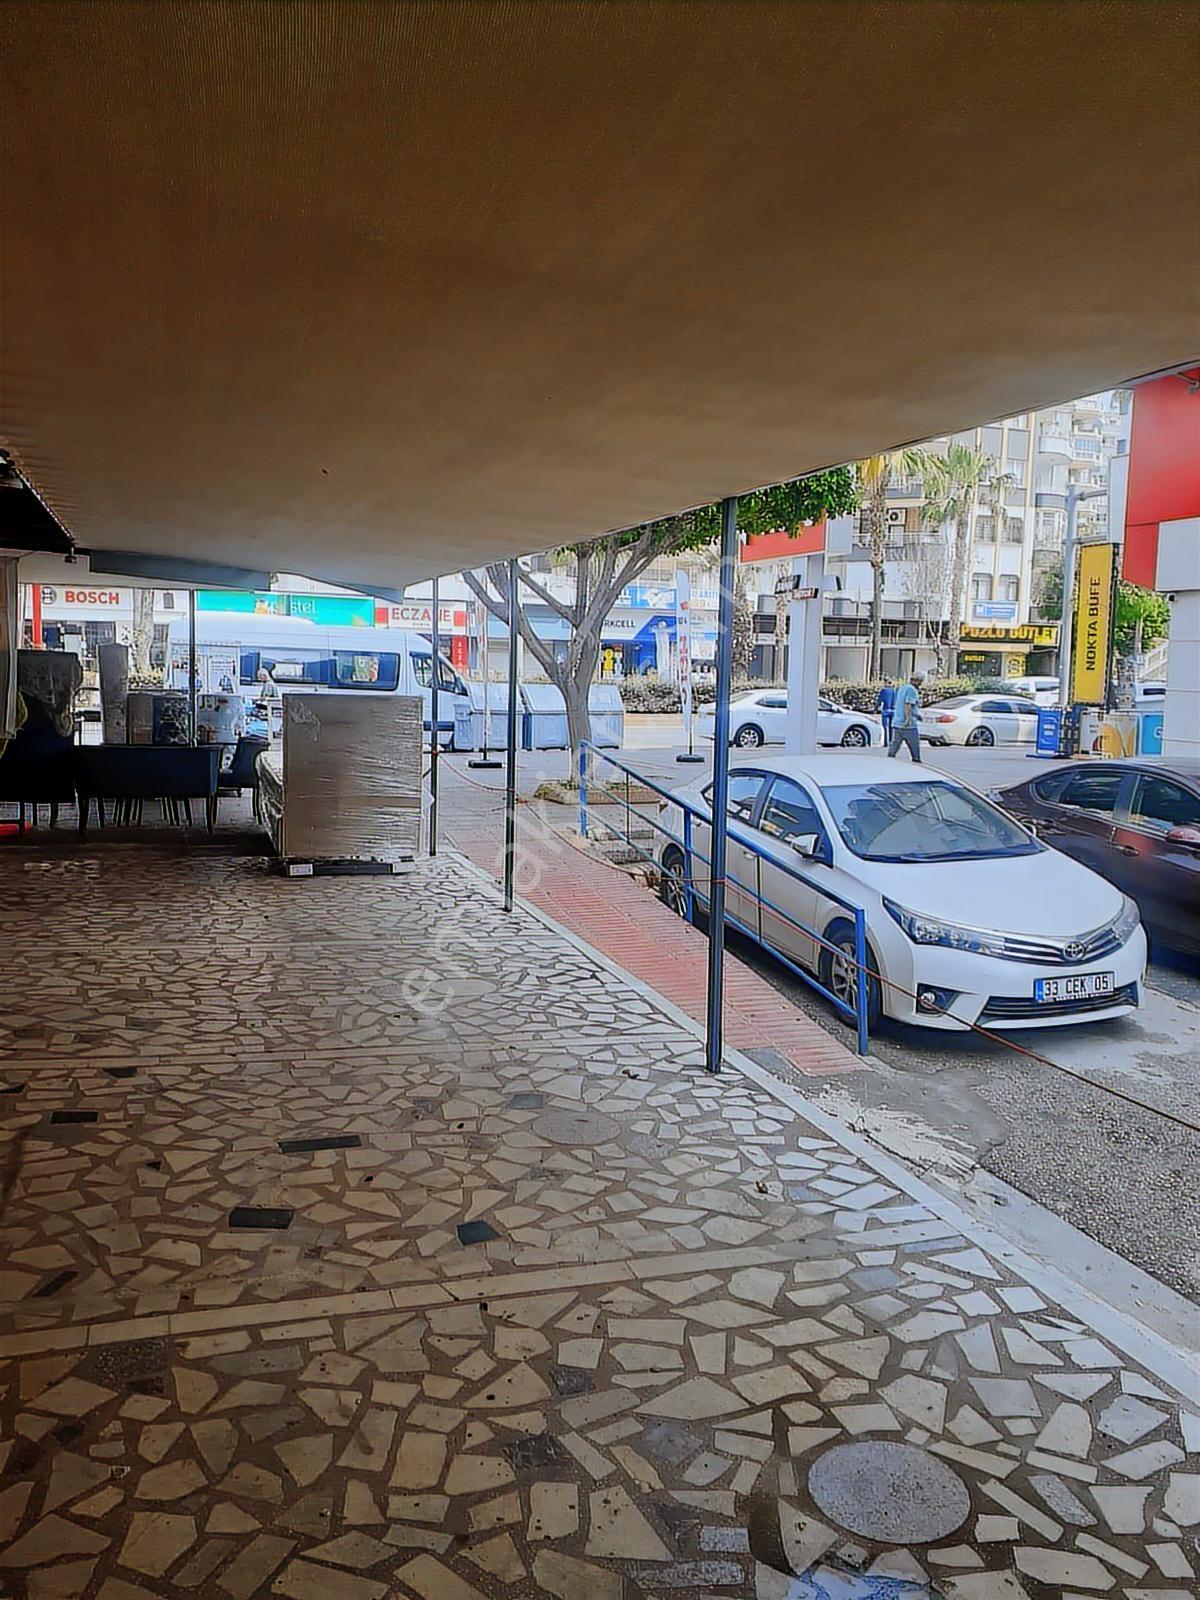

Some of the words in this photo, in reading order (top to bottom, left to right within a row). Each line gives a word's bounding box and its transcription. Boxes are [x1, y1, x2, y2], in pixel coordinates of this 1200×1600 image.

[64, 591, 120, 604] BOSCH
[1086, 620, 1099, 671] NOKTA
[1045, 981, 1059, 996] 33
[1066, 977, 1088, 994] CEK
[1095, 975, 1109, 991] 05
